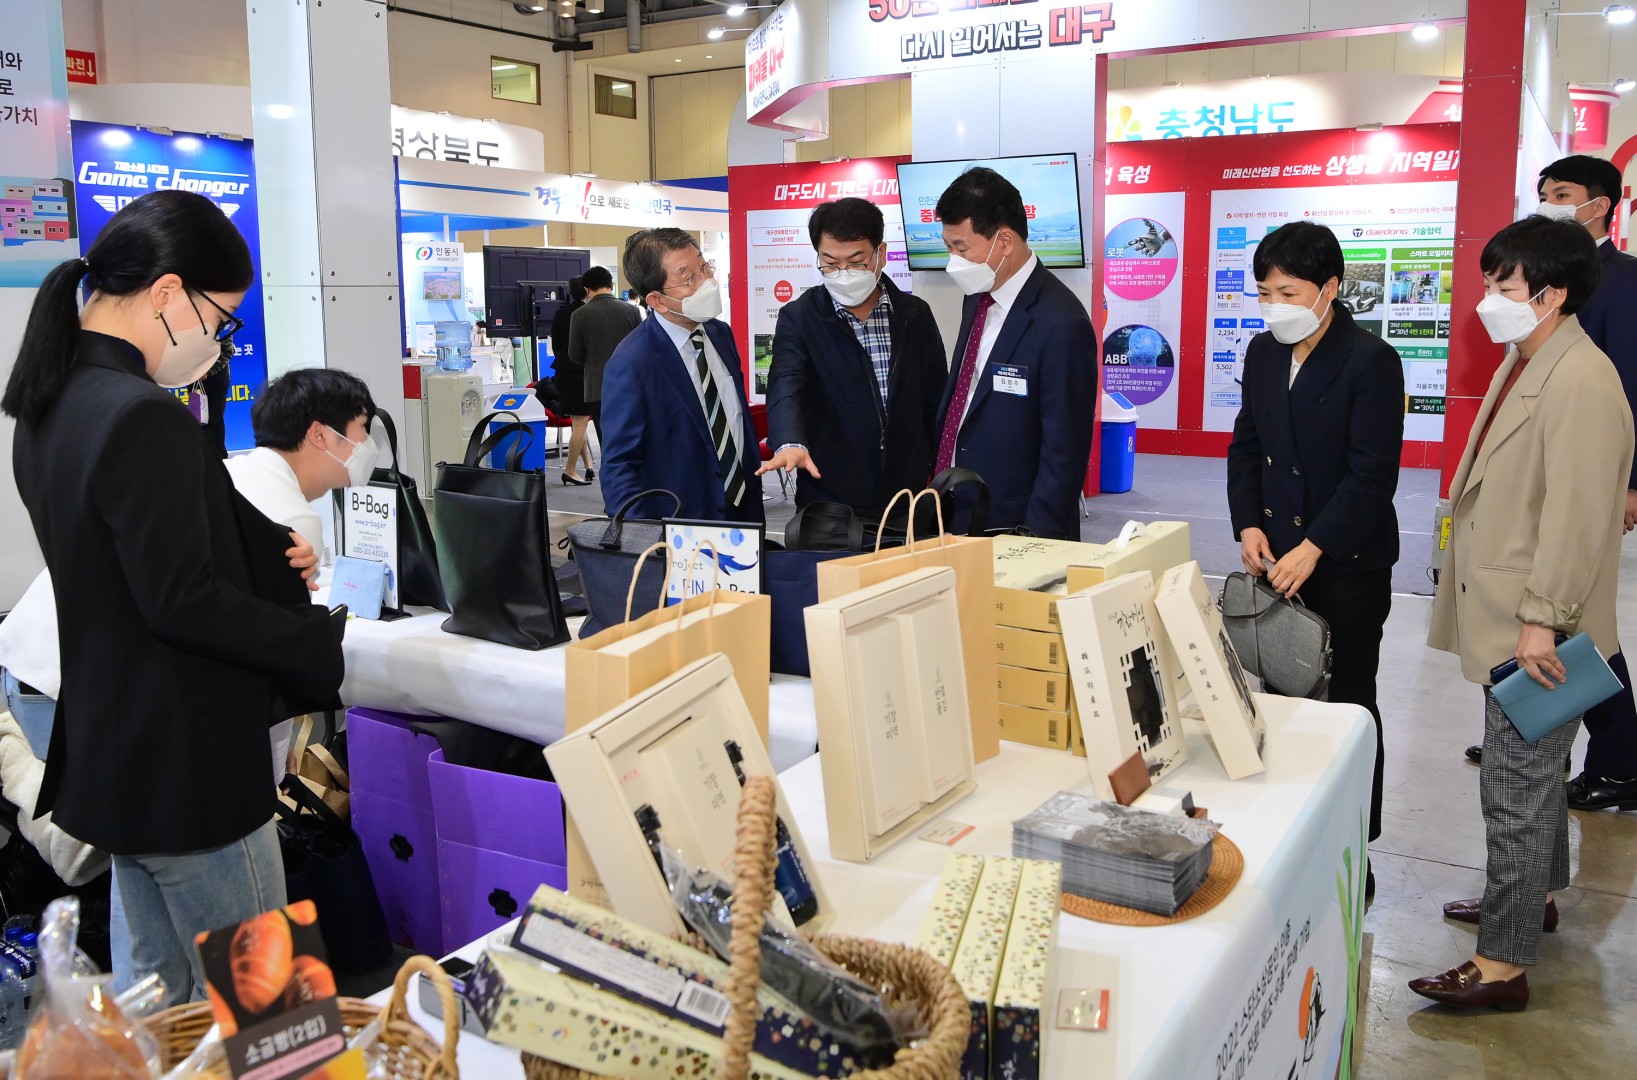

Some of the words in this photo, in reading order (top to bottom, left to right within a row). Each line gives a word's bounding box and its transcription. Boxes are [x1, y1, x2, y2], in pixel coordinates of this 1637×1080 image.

[900, 30, 944, 62] 다시
[950, 20, 1042, 57] 일어서는
[1049, 3, 1115, 46] 대구
[1155, 101, 1294, 140] 충청남도
[78, 161, 148, 188] Game
[1118, 165, 1151, 184] 육성
[1222, 165, 1280, 180] 미래신산업을
[1282, 164, 1322, 177] 선도하는
[774, 182, 826, 201] 대구도시
[828, 180, 870, 199] 그랜드
[607, 195, 631, 210] 새로운
[1412, 227, 1442, 235] 기술협력
[435, 247, 459, 257] 안동시
[1107, 247, 1125, 257] 로봇
[244, 344, 254, 356] 곳
[1104, 354, 1128, 364] ABB
[352, 492, 389, 519] B-Bag
[667, 558, 704, 571] rojct
